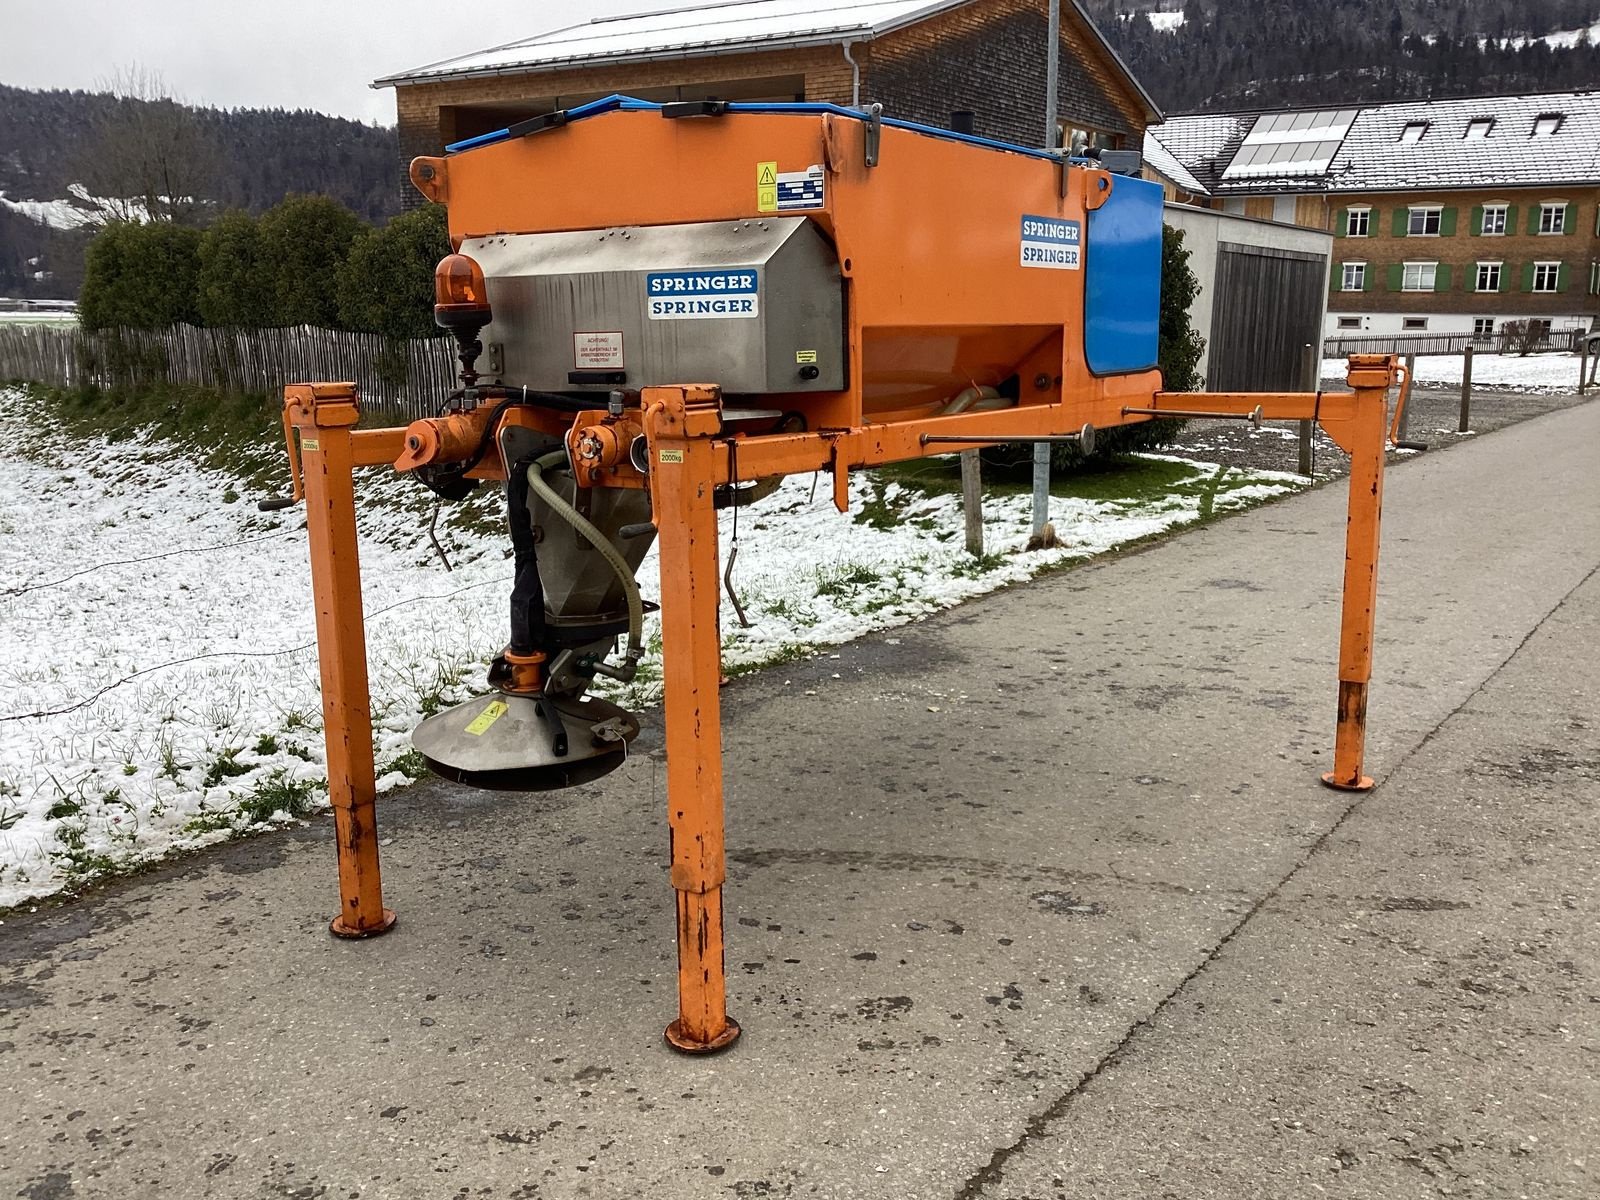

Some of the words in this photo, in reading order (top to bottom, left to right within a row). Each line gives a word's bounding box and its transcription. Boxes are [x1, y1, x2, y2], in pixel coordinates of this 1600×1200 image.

[1024, 220, 1078, 240] SPRINGER
[1023, 247, 1077, 264] SPRINGER
[652, 275, 753, 292] SPRINGER
[653, 300, 753, 314] SPRINGER
